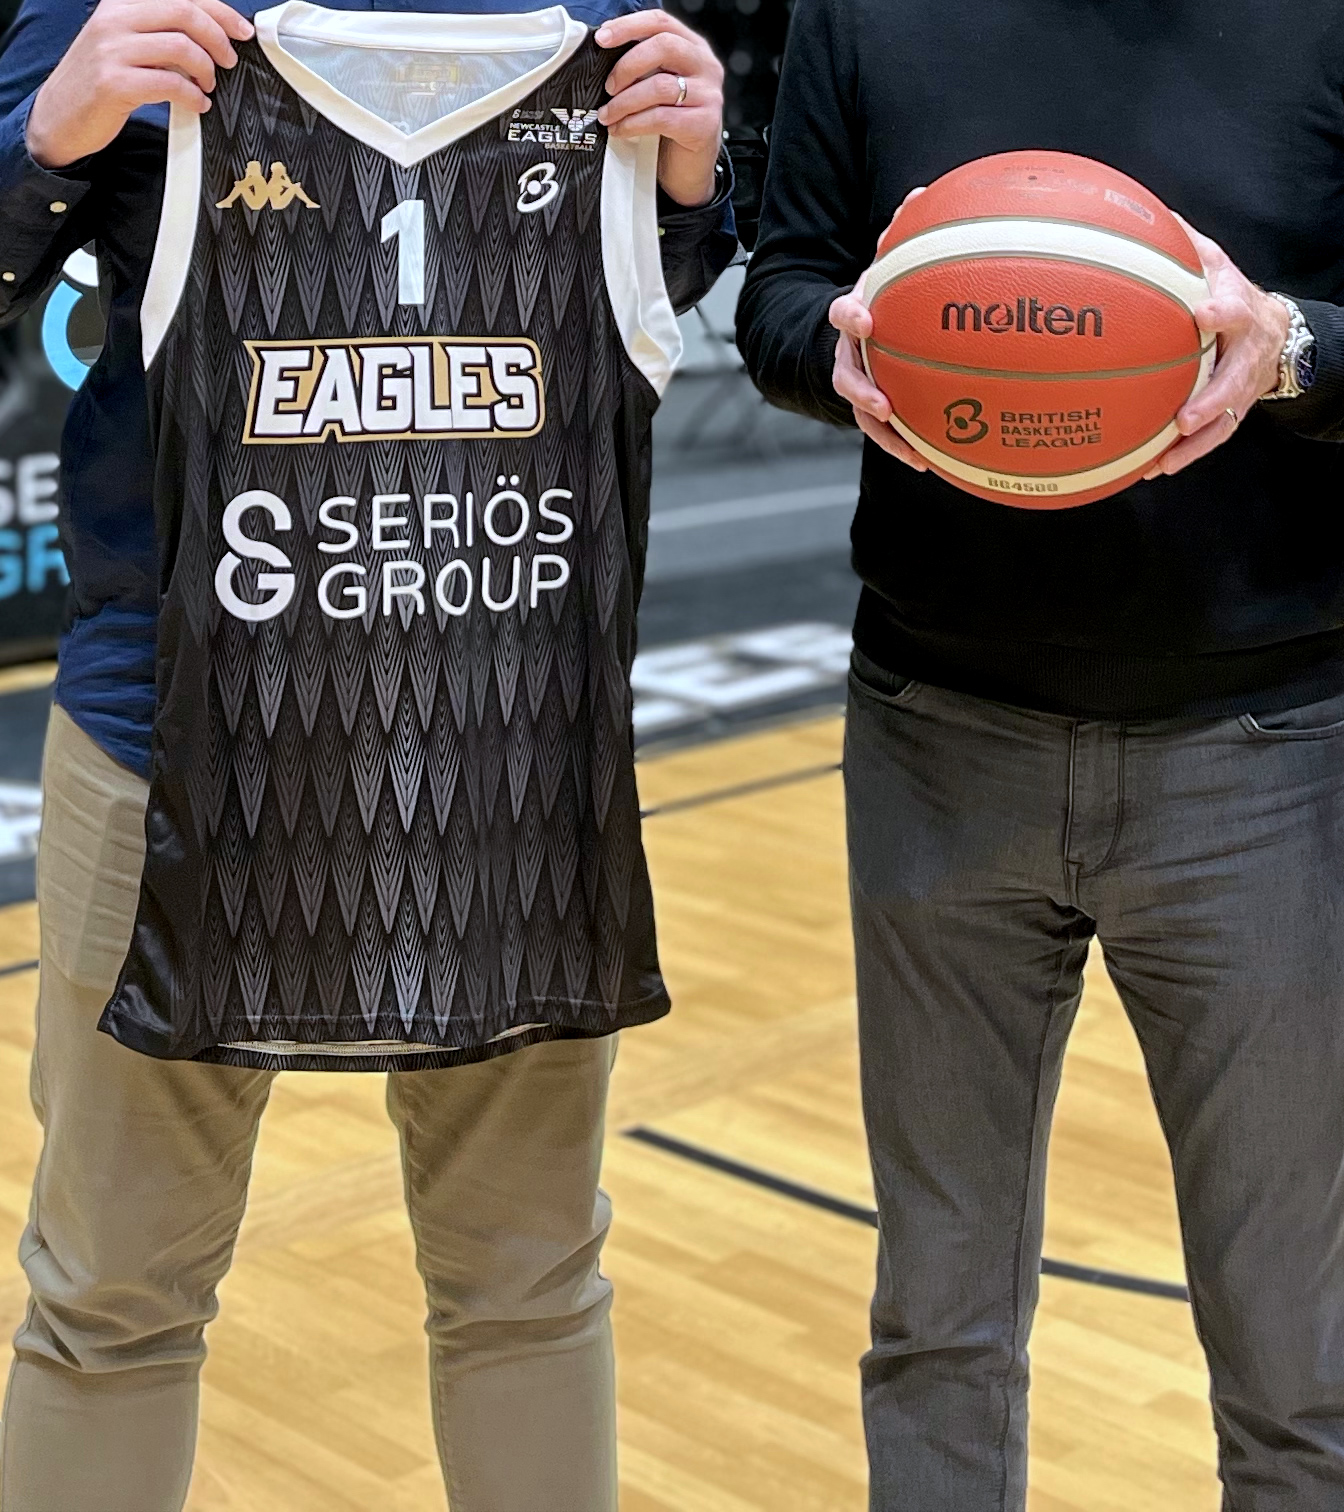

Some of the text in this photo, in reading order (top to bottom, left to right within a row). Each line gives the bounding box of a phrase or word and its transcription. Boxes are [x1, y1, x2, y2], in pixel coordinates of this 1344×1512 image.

[507, 129, 598, 145] EAGLES
[544, 143, 594, 151] BASKETBALL
[380, 199, 425, 305] 1
[941, 296, 1103, 337] molten
[248, 341, 543, 438] EAGLES
[1000, 407, 1102, 425] BRITISH
[1000, 421, 1102, 437] BASKETBALL
[1001, 433, 1102, 449] LEAGUE
[987, 476, 1059, 493] BG4500
[316, 474, 574, 555] SERIÖS
[316, 553, 572, 620] GROUP
